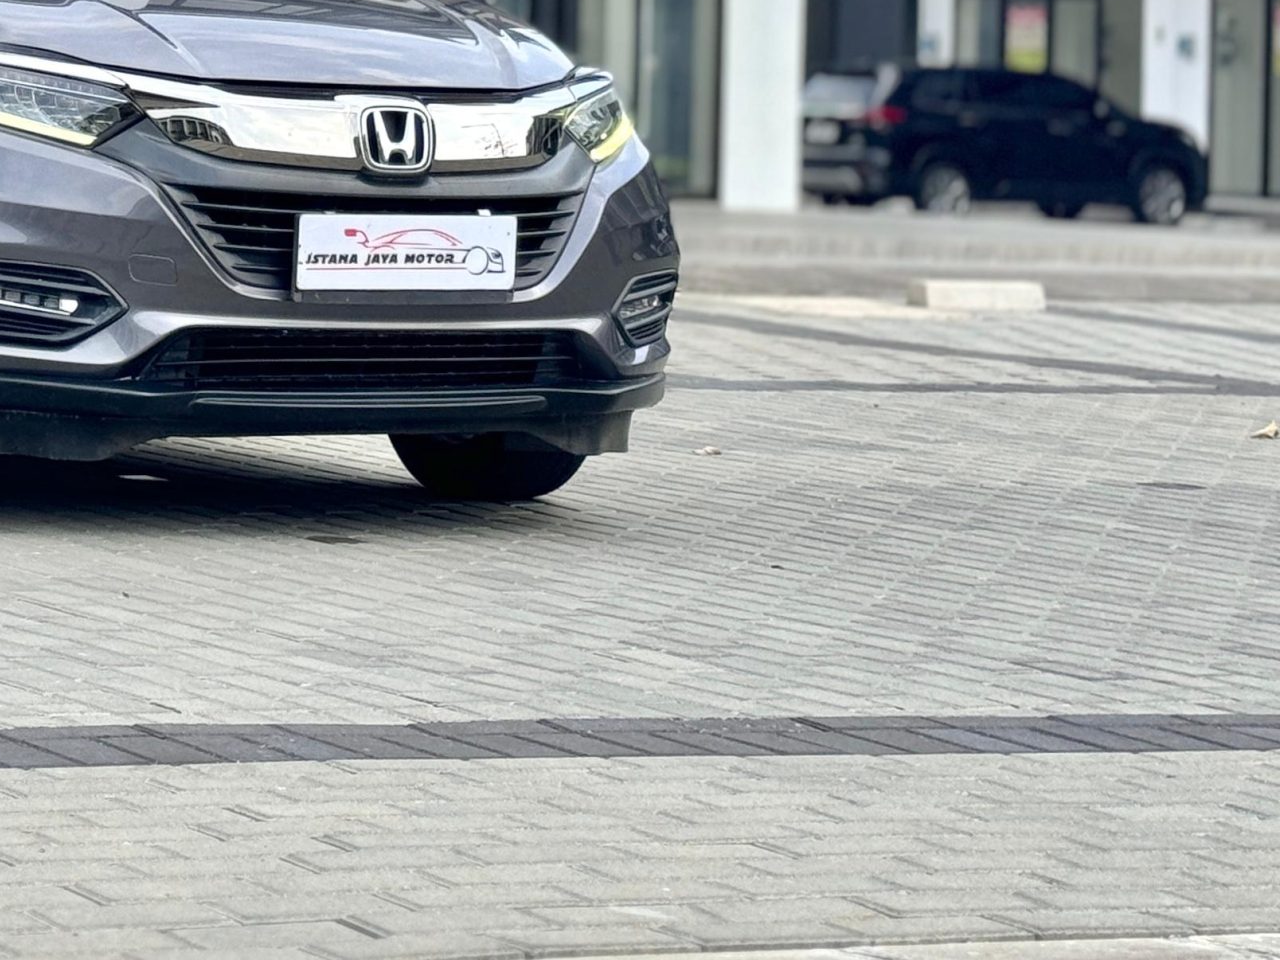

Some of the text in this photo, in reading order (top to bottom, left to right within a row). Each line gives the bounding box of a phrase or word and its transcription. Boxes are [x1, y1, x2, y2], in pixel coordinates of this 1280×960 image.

[306, 252, 455, 266] ISTANA JAYA MOTOR
